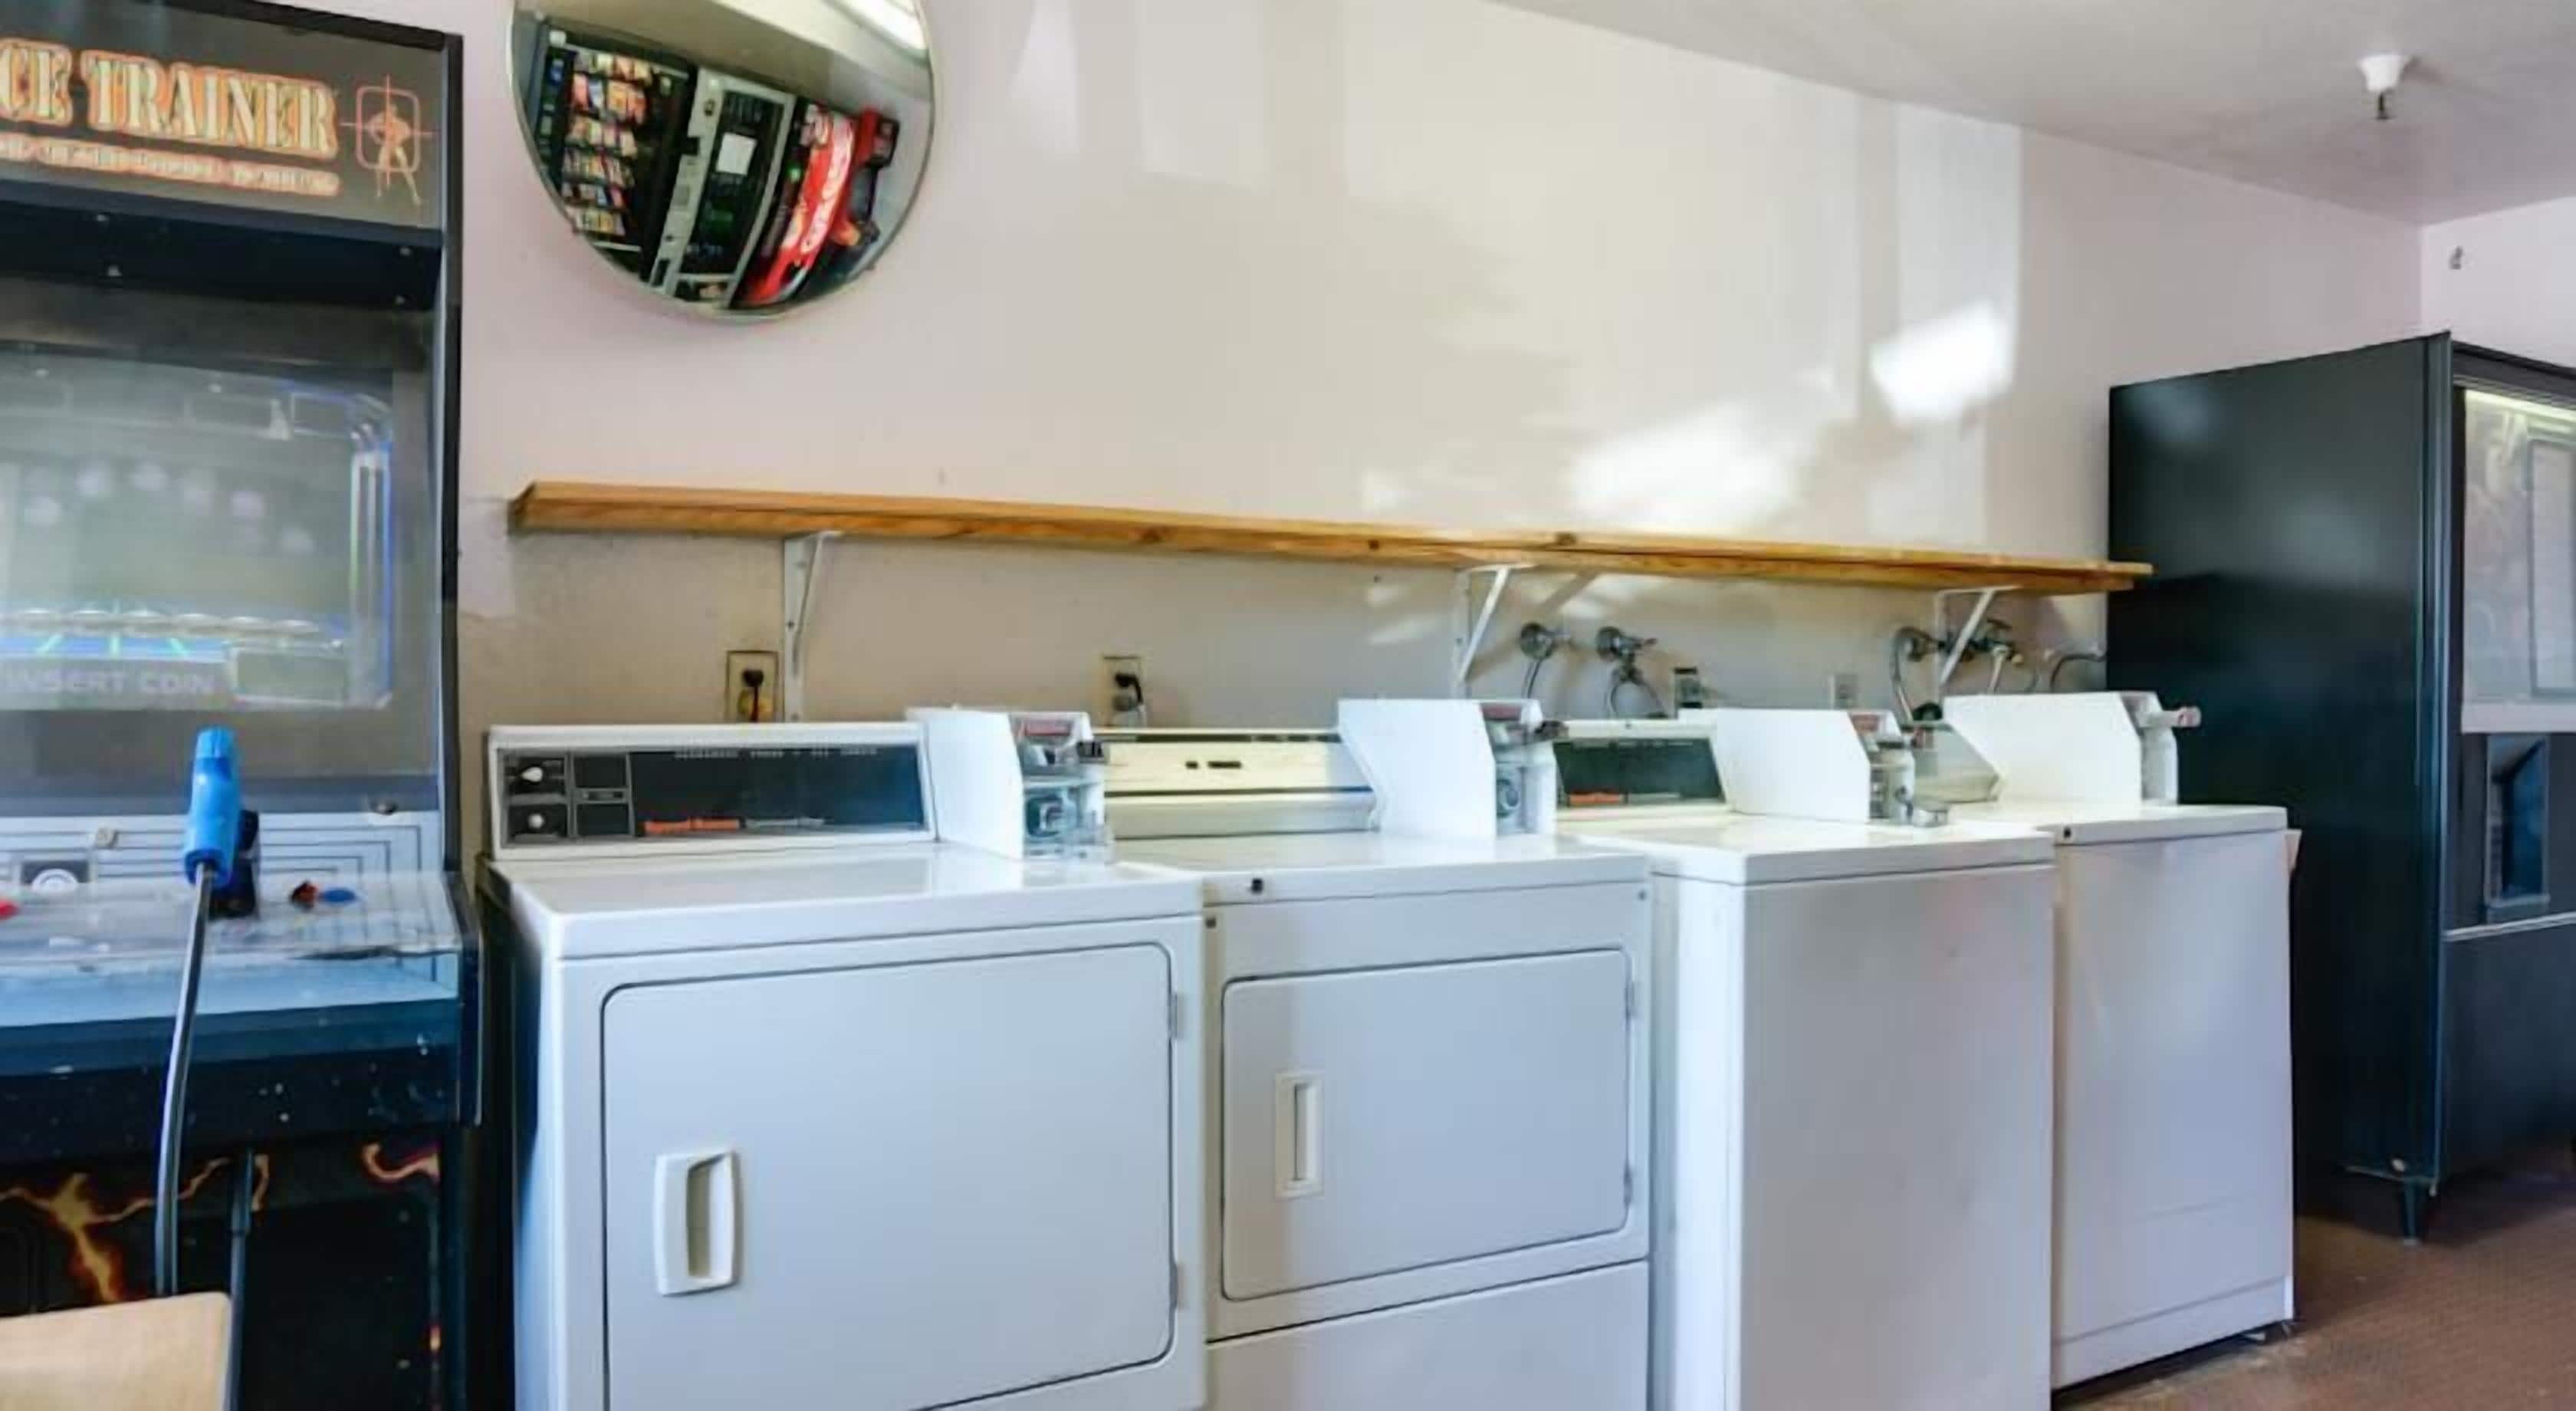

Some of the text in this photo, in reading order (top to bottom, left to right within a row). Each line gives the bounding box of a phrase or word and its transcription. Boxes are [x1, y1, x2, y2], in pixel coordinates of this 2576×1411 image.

[87, 55, 333, 153] TRAINER
[5, 666, 215, 696] INSERT COIN
